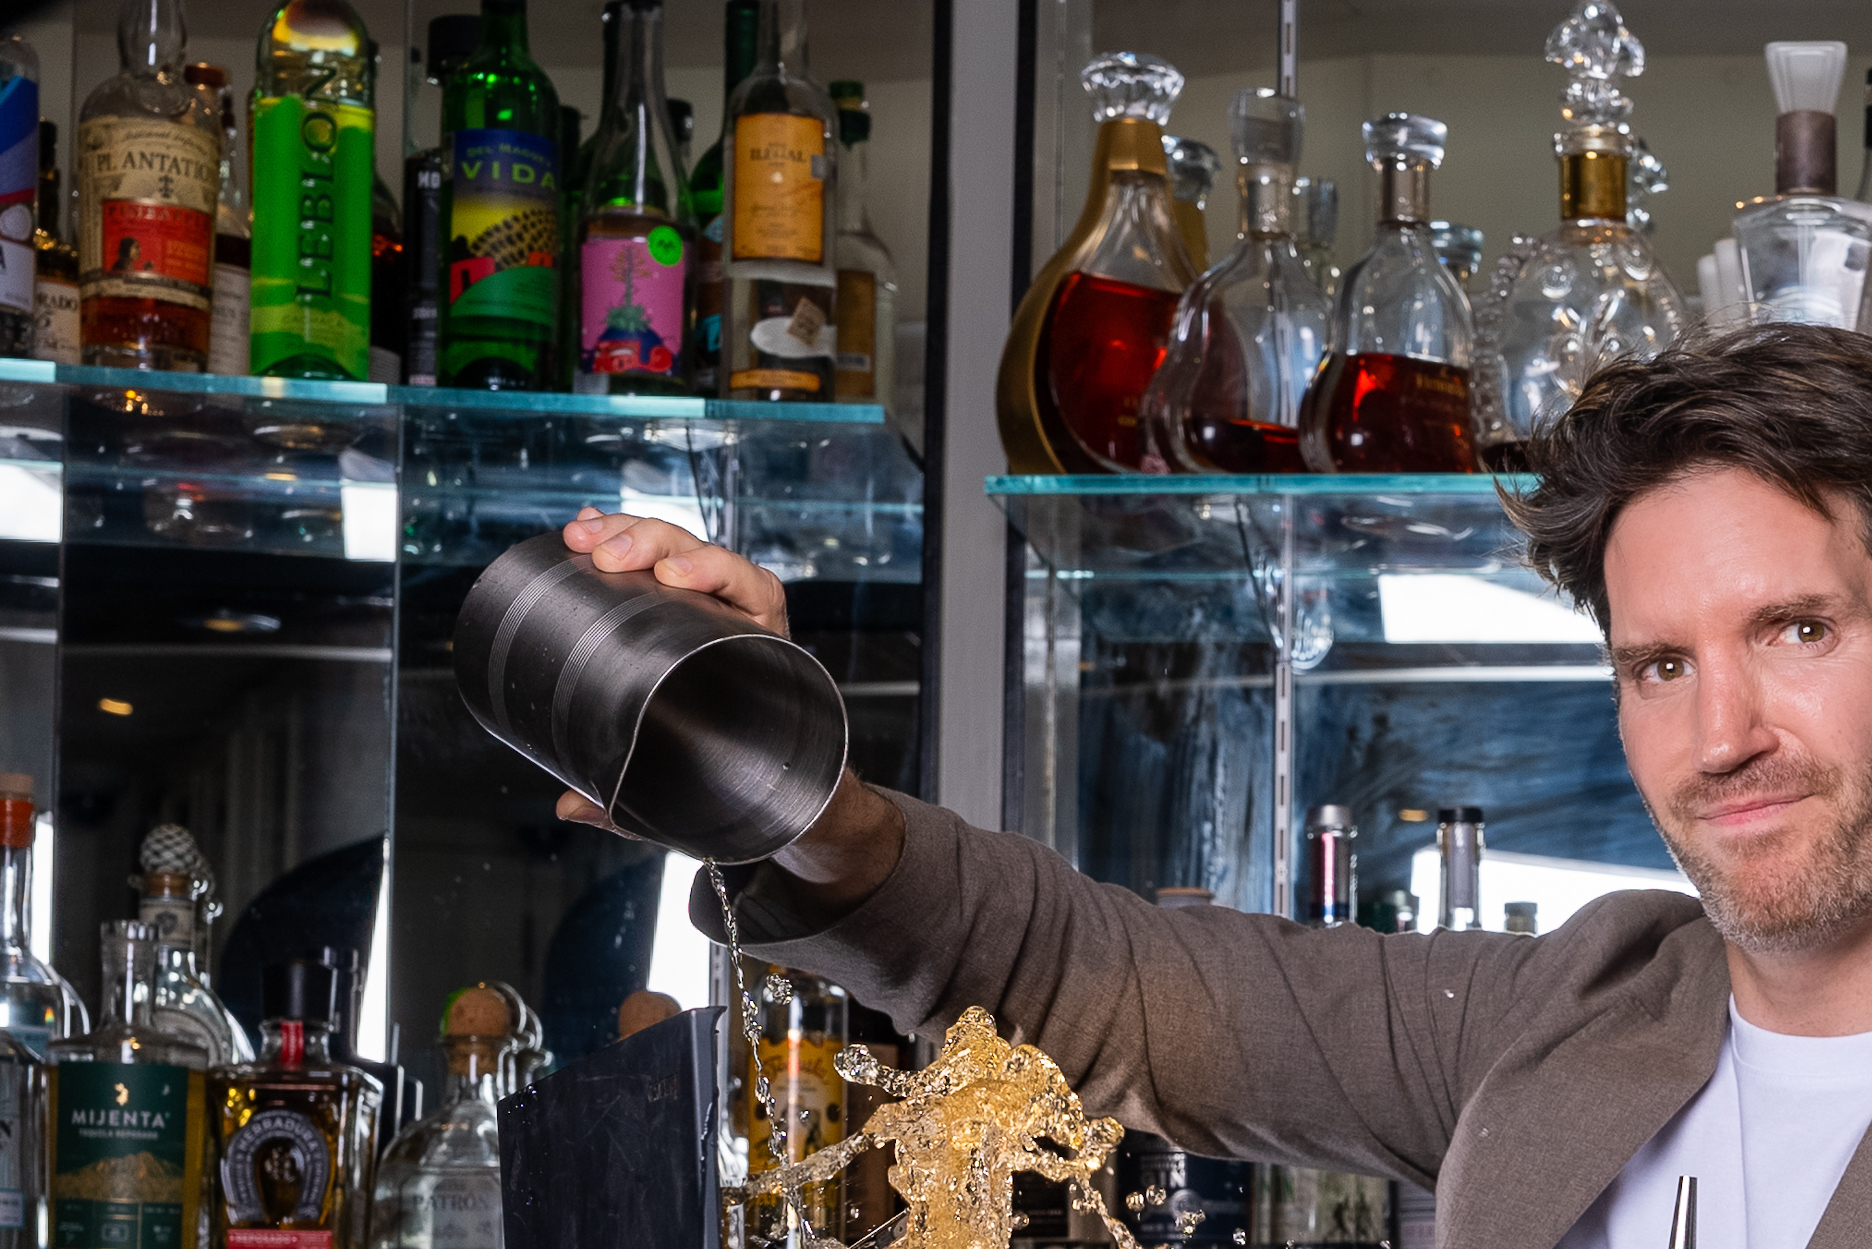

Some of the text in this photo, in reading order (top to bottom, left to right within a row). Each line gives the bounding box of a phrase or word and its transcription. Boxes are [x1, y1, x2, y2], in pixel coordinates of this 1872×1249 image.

[297, 64, 338, 298] LEBLON
[461, 161, 556, 190] VIDA
[71, 1109, 166, 1129] MIJENTA
